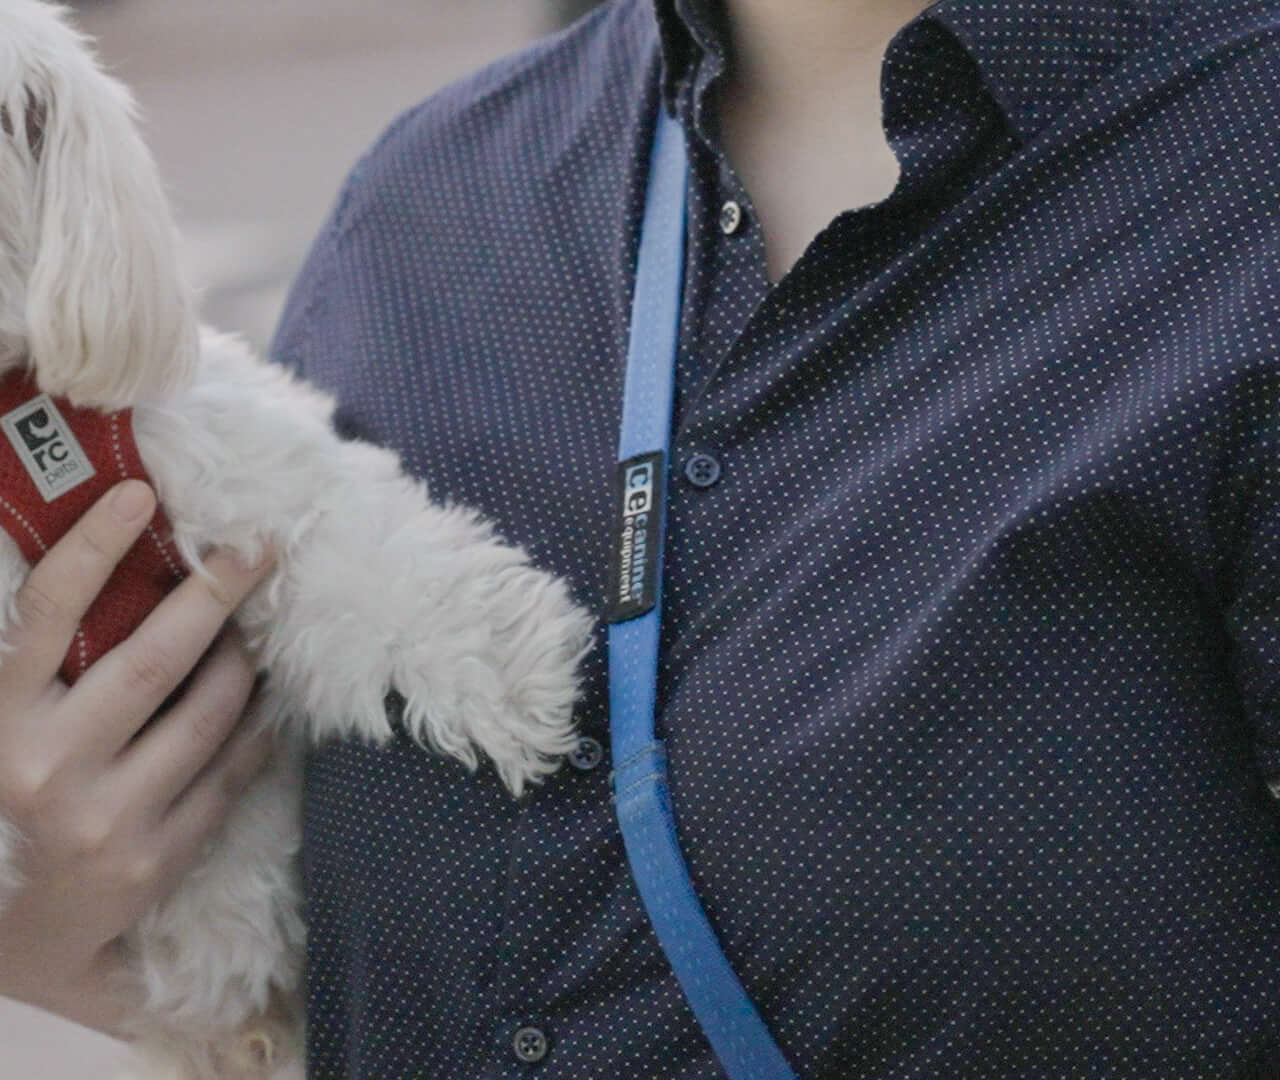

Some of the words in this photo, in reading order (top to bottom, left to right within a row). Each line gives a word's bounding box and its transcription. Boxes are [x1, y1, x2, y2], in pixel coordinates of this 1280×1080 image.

[32, 440, 69, 472] rc
[45, 460, 79, 487] pets
[619, 516, 634, 605] equipment
